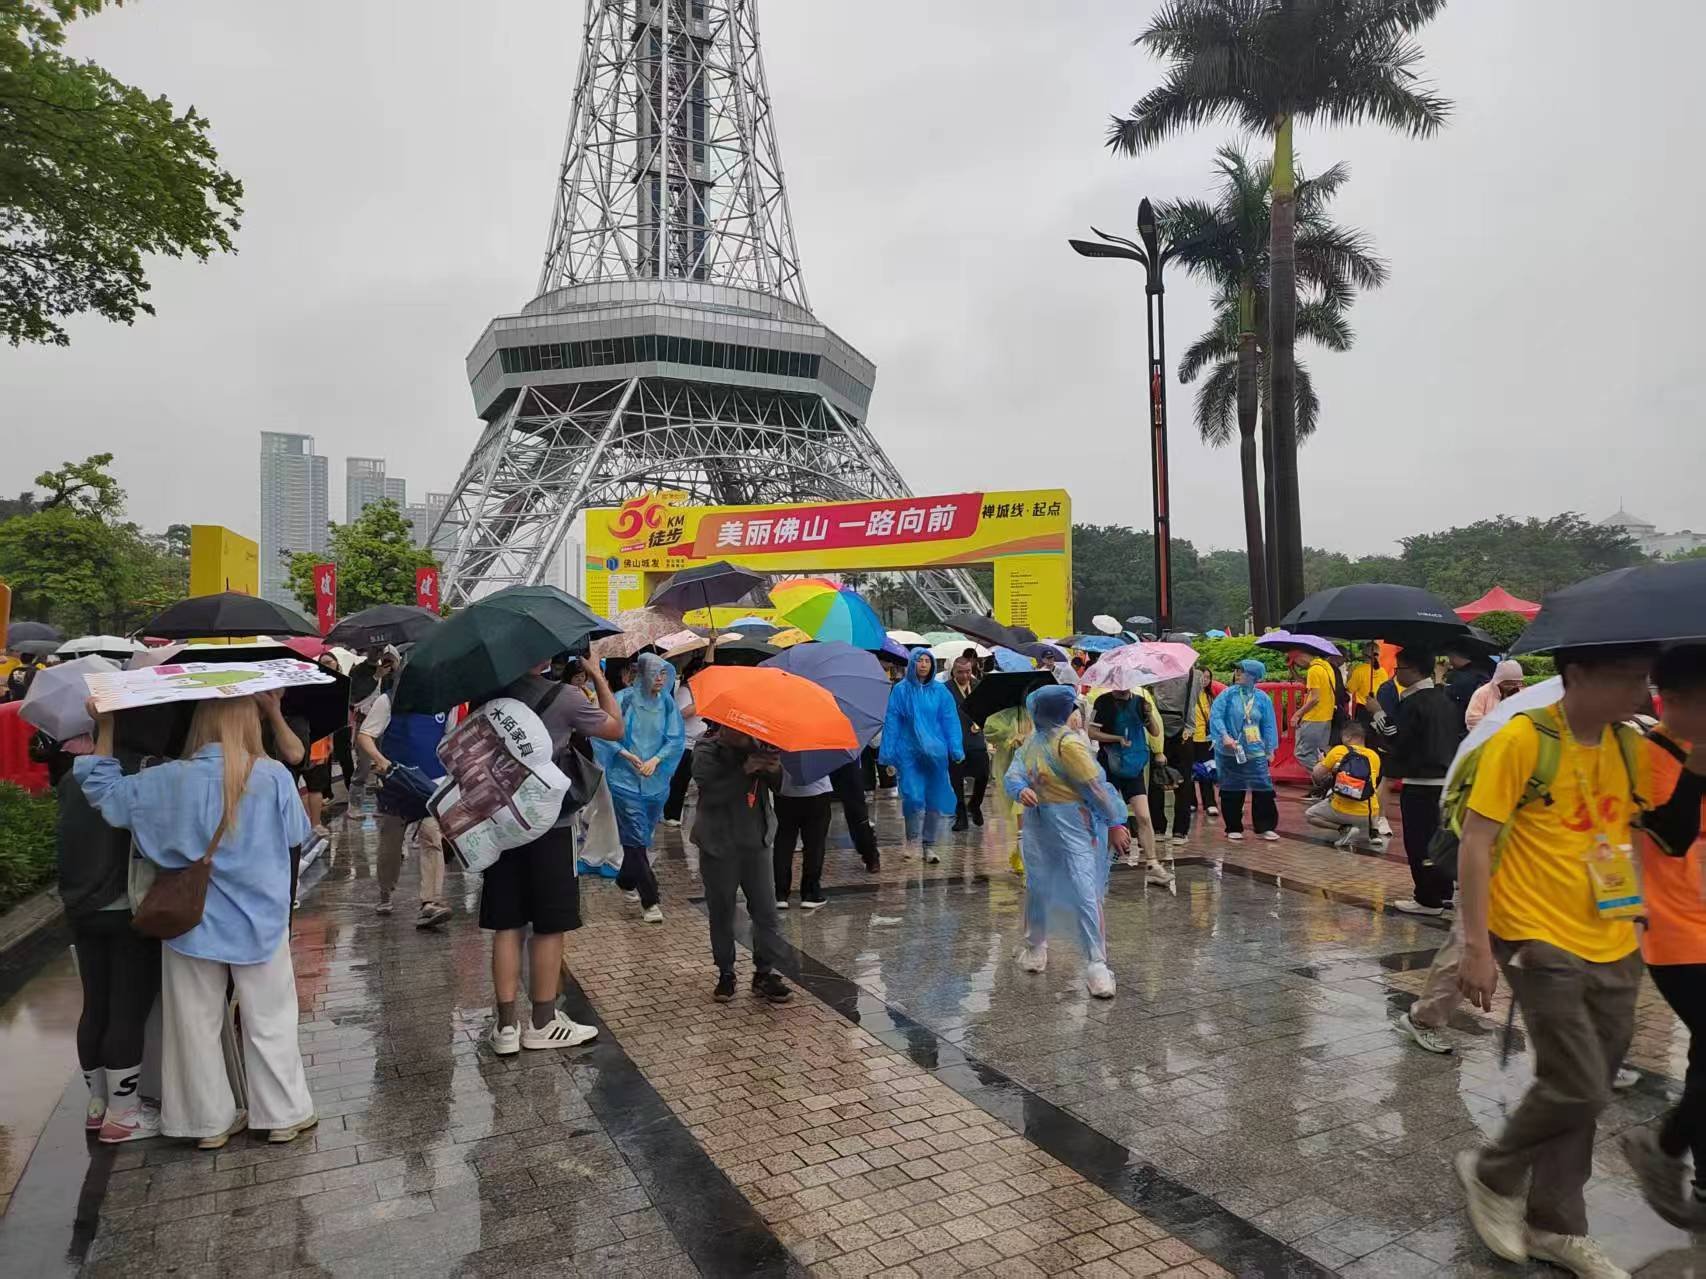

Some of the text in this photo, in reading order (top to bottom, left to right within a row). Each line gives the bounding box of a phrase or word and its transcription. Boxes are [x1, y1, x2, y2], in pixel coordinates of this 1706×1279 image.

[667, 515, 685, 528] KM
[716, 504, 958, 547] 美丽佛山 一路向前
[648, 528, 683, 548] 徒步
[490, 707, 534, 757] 木陌家具
